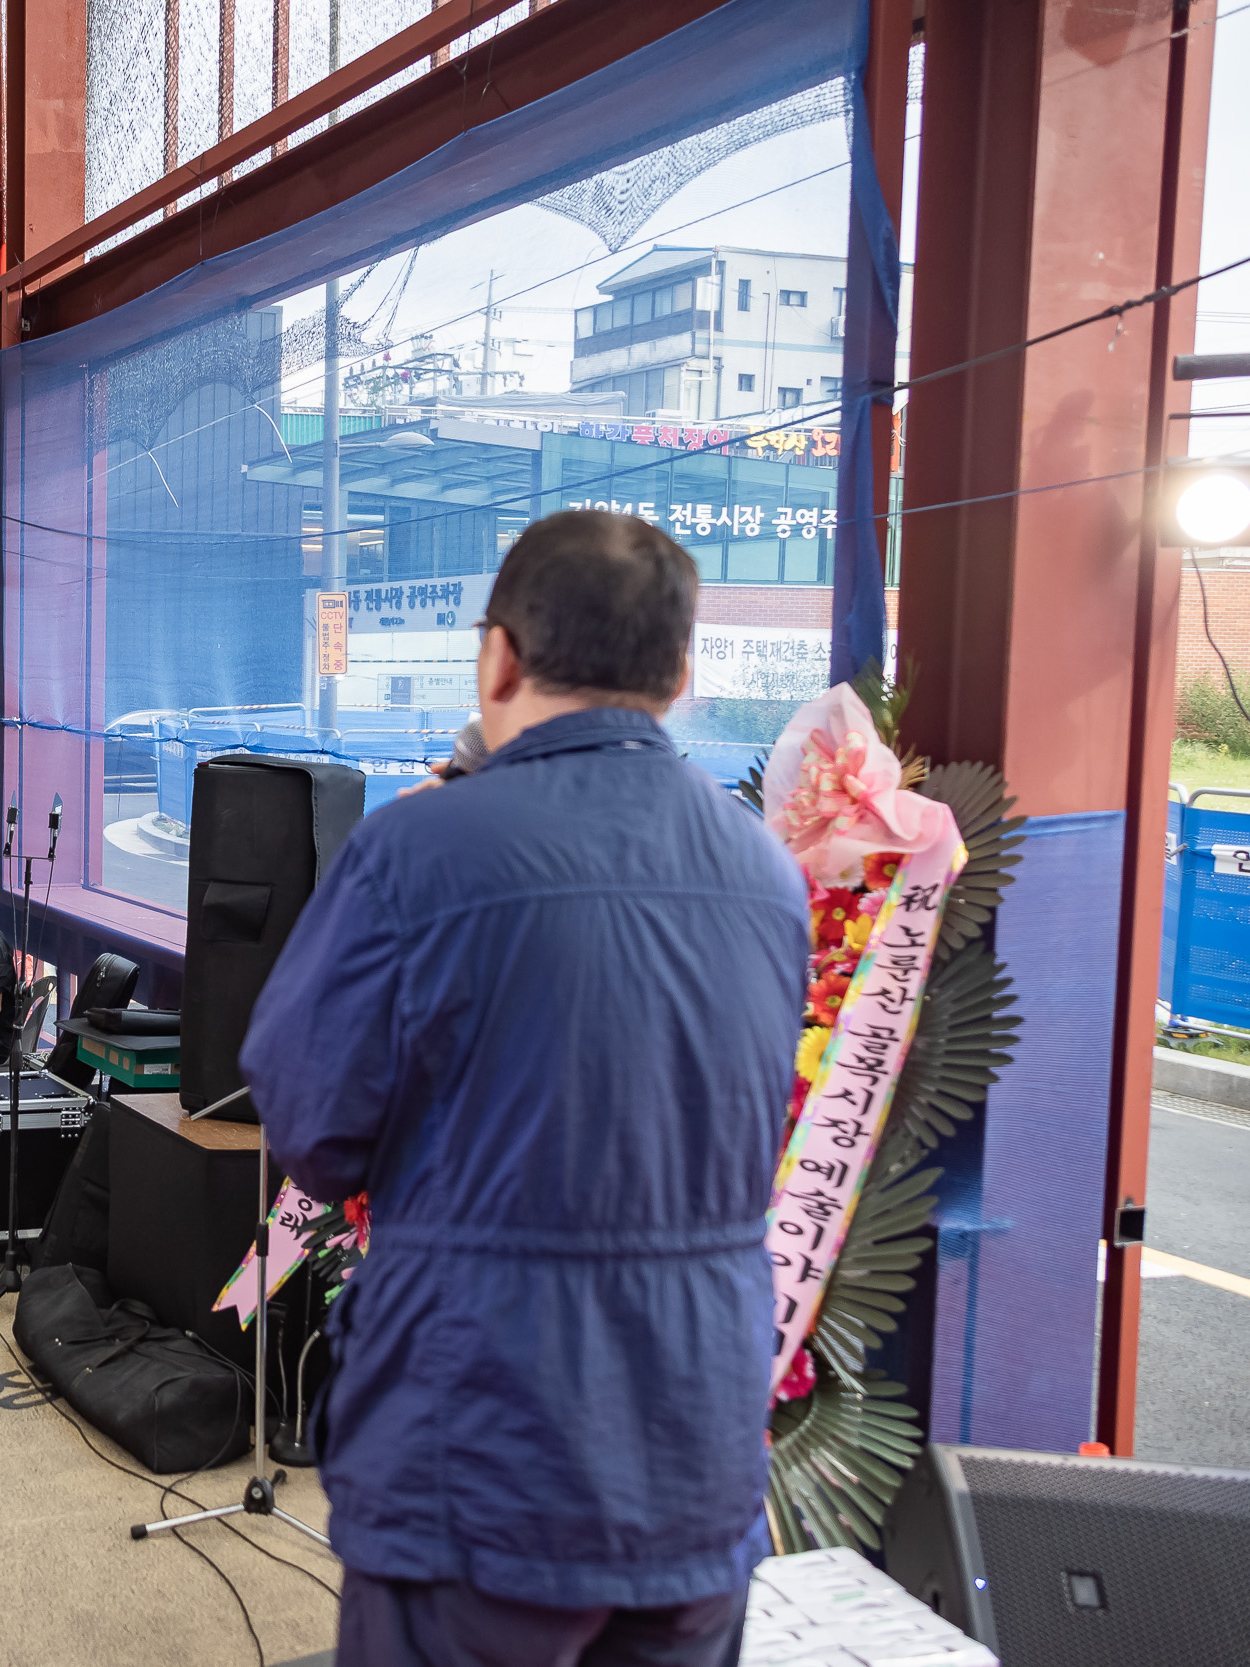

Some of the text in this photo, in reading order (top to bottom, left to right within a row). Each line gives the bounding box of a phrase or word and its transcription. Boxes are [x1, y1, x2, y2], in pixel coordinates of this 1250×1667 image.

[668, 503, 765, 537] 전통시장
[321, 612, 344, 620] CCTV
[701, 637, 734, 661] 자양1
[861, 925, 926, 1014] 노룬산
[813, 1023, 900, 1149] 골목시장
[770, 1157, 848, 1283] 예술이야
